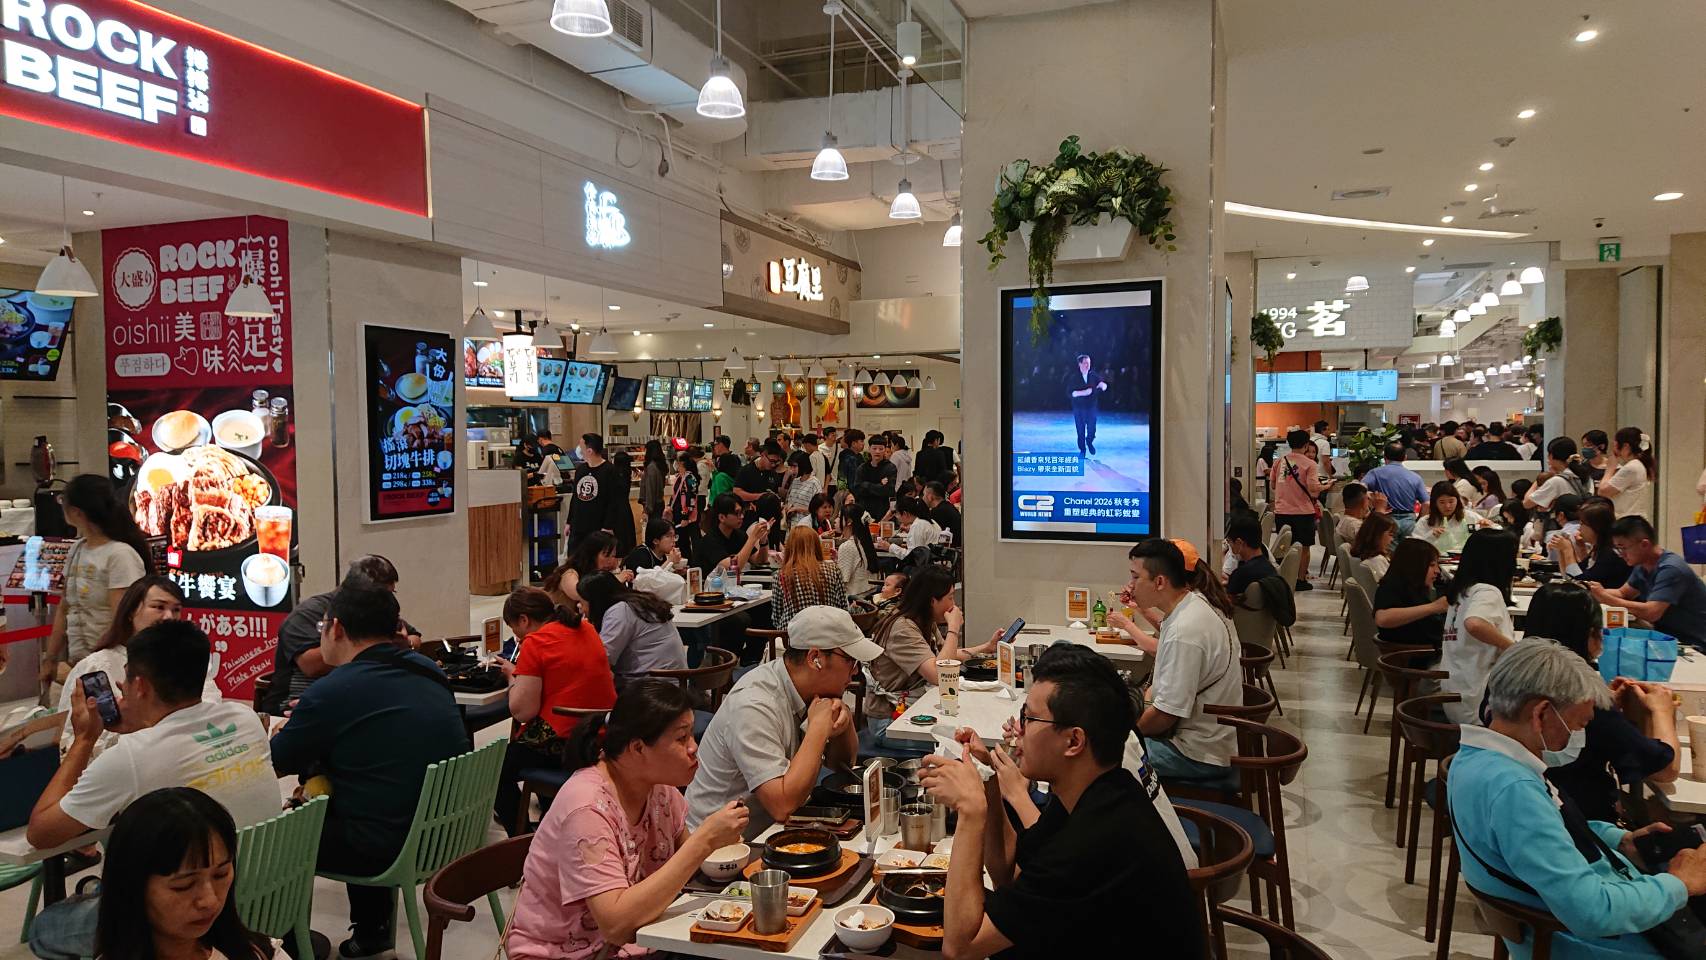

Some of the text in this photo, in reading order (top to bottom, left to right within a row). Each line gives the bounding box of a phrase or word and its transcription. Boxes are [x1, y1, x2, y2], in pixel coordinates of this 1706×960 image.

[2, 0, 178, 80] ROCK
[3, 39, 178, 124] BEEF
[160, 239, 236, 272] ROCK
[119, 270, 152, 289] 大盛り
[160, 275, 225, 304] BEEF
[238, 248, 268, 358] 爆足
[113, 316, 170, 345] oishii
[174, 311, 196, 342] 美
[269, 299, 284, 356] Tasty
[1306, 299, 1351, 337] 茗
[202, 345, 225, 374] 味
[385, 449, 436, 471] 切塊牛排
[1018, 494, 1055, 511] C2
[1064, 497, 1140, 507] Chanel 2026 秋冬秀
[168, 572, 237, 601] 牛饗宴
[187, 612, 267, 638] がある!!!
[222, 645, 262, 671] Taiwanese
[227, 658, 272, 687] Plate Steak
[205, 743, 250, 763] adidas
